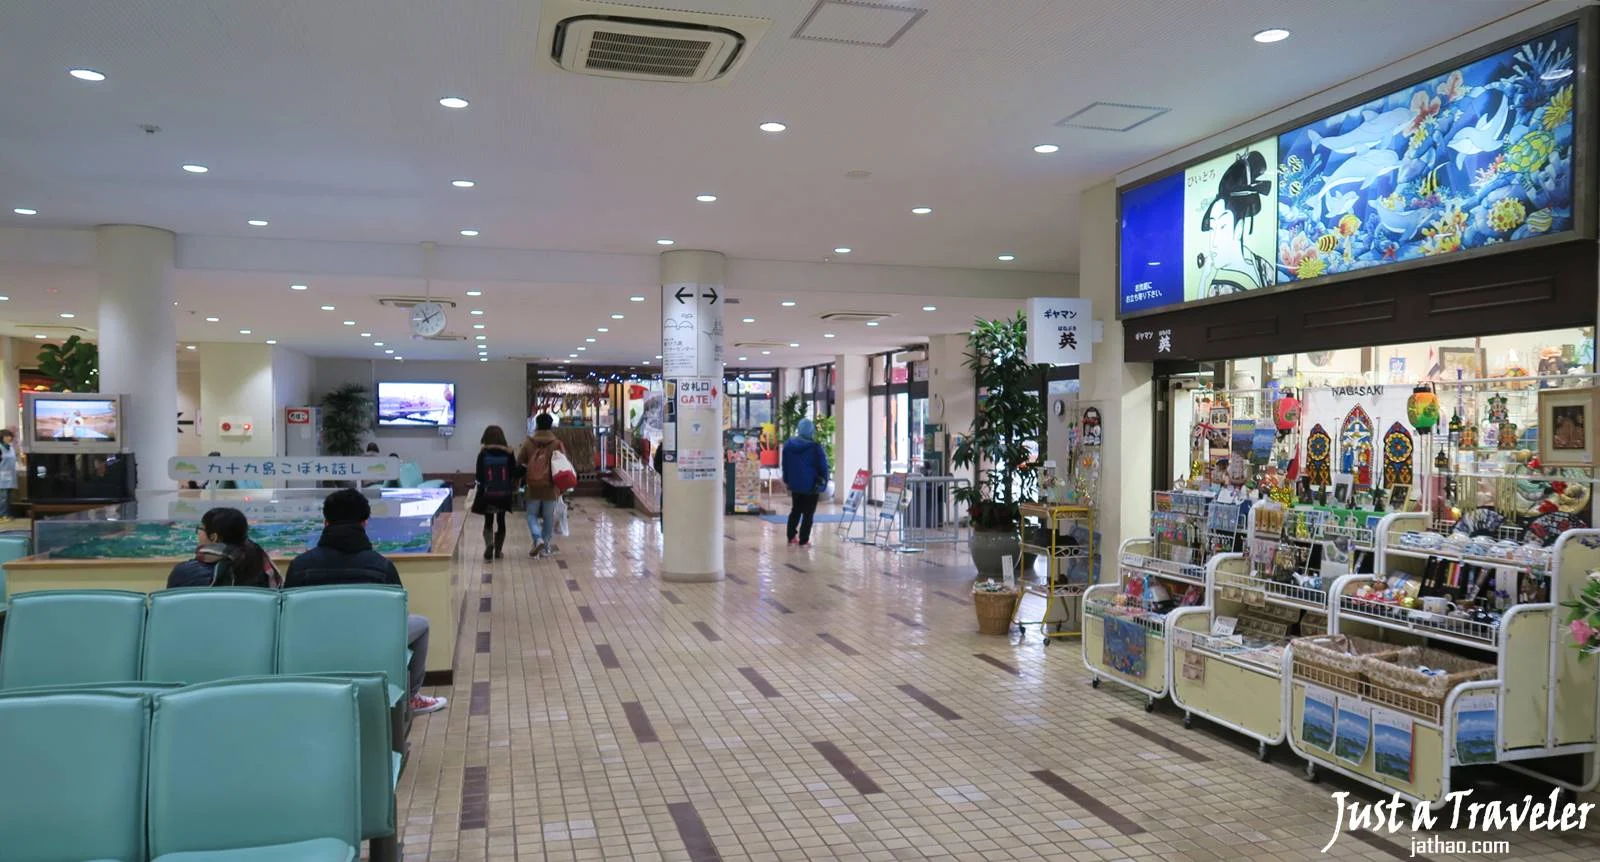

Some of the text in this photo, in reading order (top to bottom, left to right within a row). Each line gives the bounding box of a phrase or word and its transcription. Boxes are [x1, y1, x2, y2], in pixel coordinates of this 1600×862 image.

[1058, 331, 1078, 351] 英
[1158, 335, 1171, 352] 英
[681, 382, 709, 391] 改札口
[1331, 385, 1384, 396] NAGASAKI
[681, 395, 708, 404] GATE
[208, 461, 361, 475] 九十九島こぼれ話し
